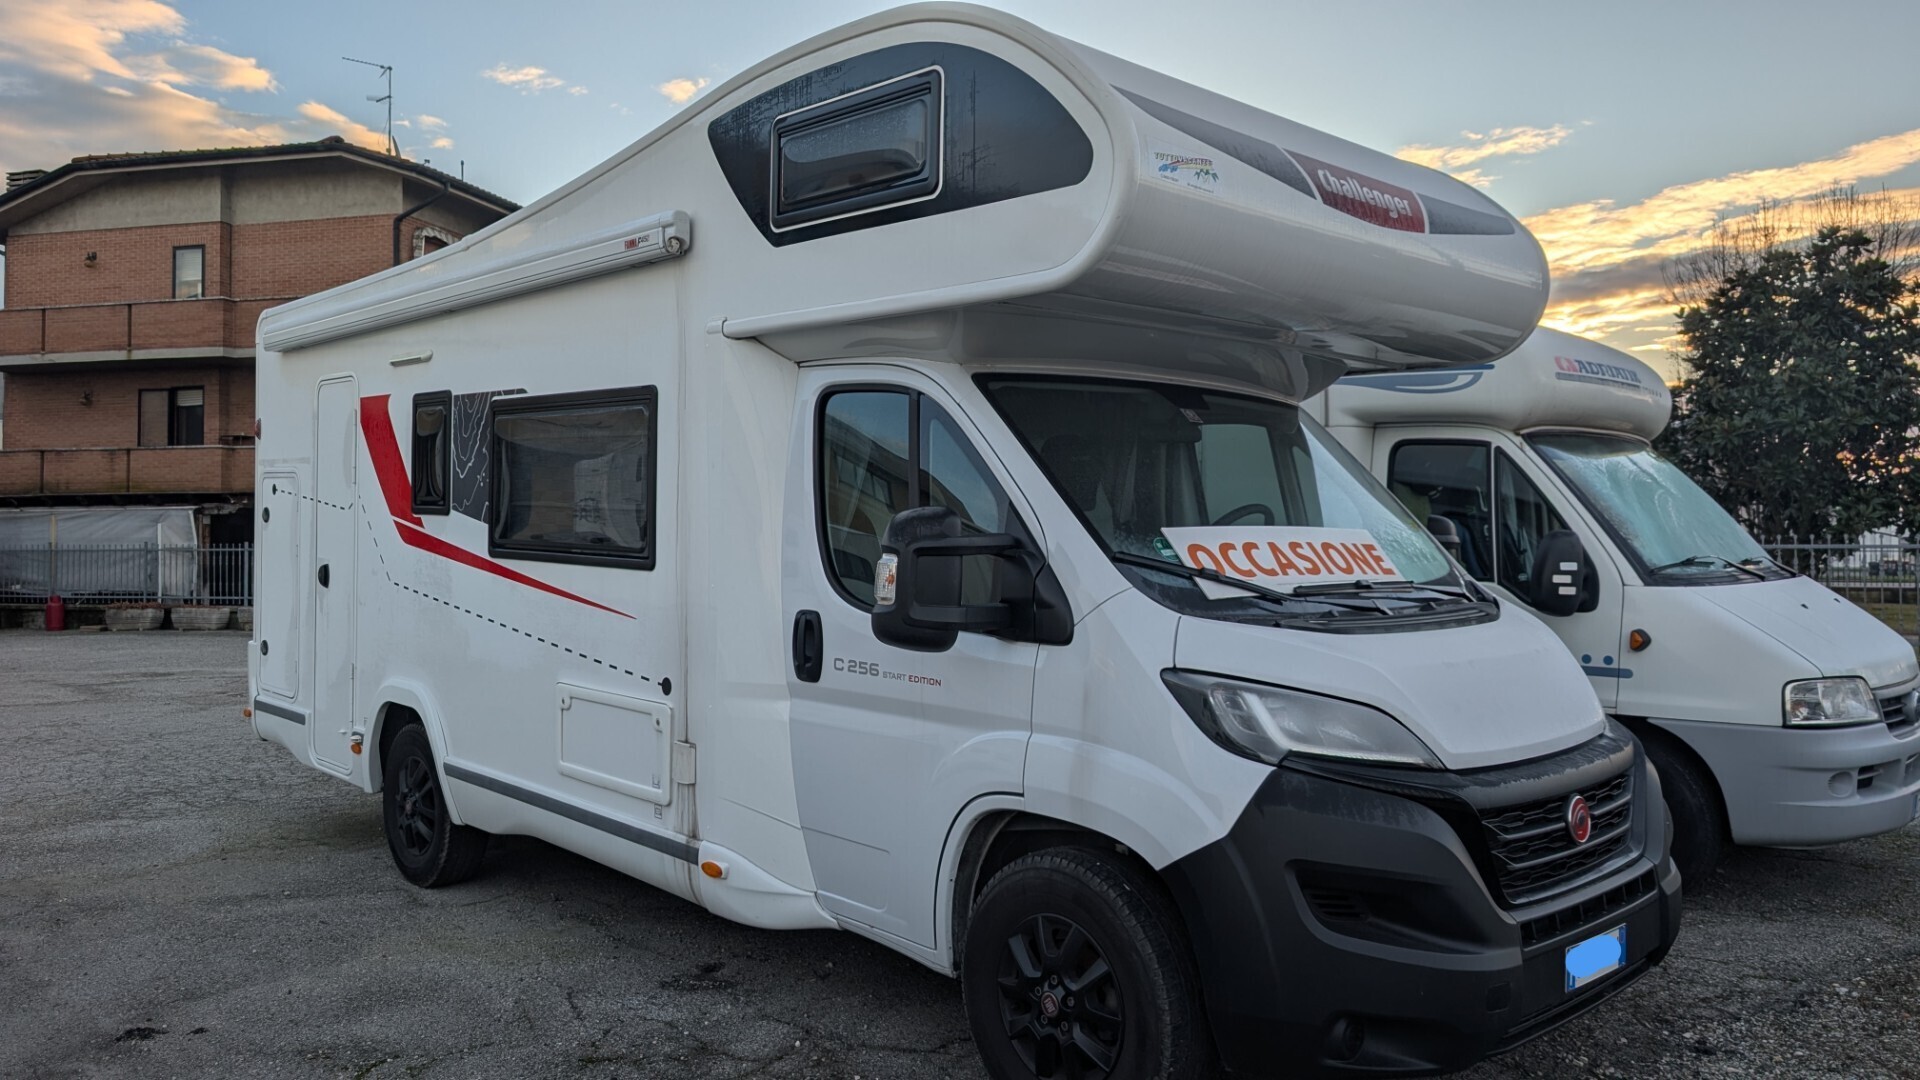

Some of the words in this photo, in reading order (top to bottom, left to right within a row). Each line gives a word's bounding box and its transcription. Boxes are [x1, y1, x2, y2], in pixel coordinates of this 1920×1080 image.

[1316, 168, 1413, 219] Challenger
[1186, 541, 1397, 579] OCCASIONE
[833, 657, 845, 671] C
[847, 659, 880, 677] 256
[882, 671, 906, 682] START
[908, 674, 942, 687] EDITION
